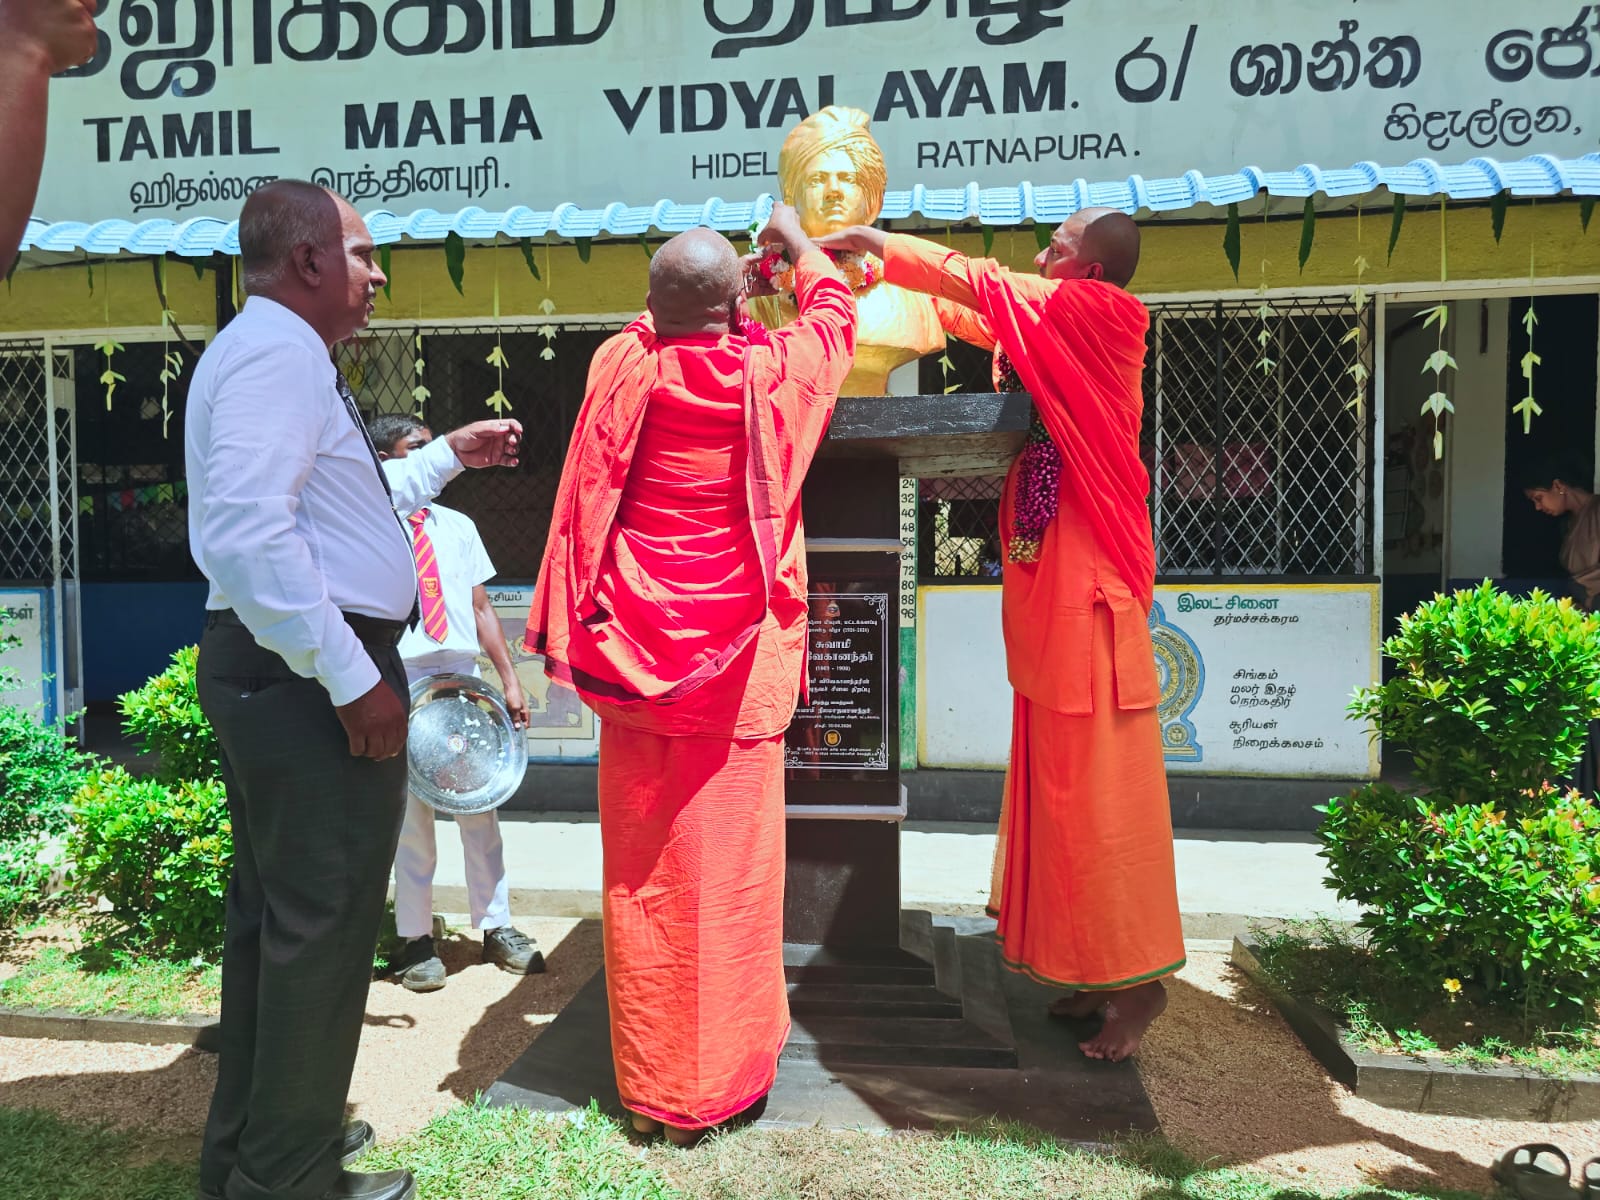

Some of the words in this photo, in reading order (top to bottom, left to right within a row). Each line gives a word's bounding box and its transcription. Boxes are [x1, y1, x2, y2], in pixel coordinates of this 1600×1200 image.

[83, 109, 281, 163] TAMIL
[344, 94, 543, 150] MAHA
[692, 151, 779, 180] HIDEL
[917, 132, 1141, 169] RATNAPURA.
[902, 479, 915, 489] 24
[901, 493, 915, 503] 32
[901, 508, 915, 517] 40
[901, 522, 915, 532] 48
[902, 537, 915, 547] 56
[902, 566, 915, 576] 72
[901, 580, 915, 590] 80
[901, 594, 915, 605] 88
[901, 608, 915, 619] 96
[1232, 668, 1279, 680] சிங்கம்
[1231, 683, 1260, 696] மலர்
[1264, 683, 1297, 698] இதழ்
